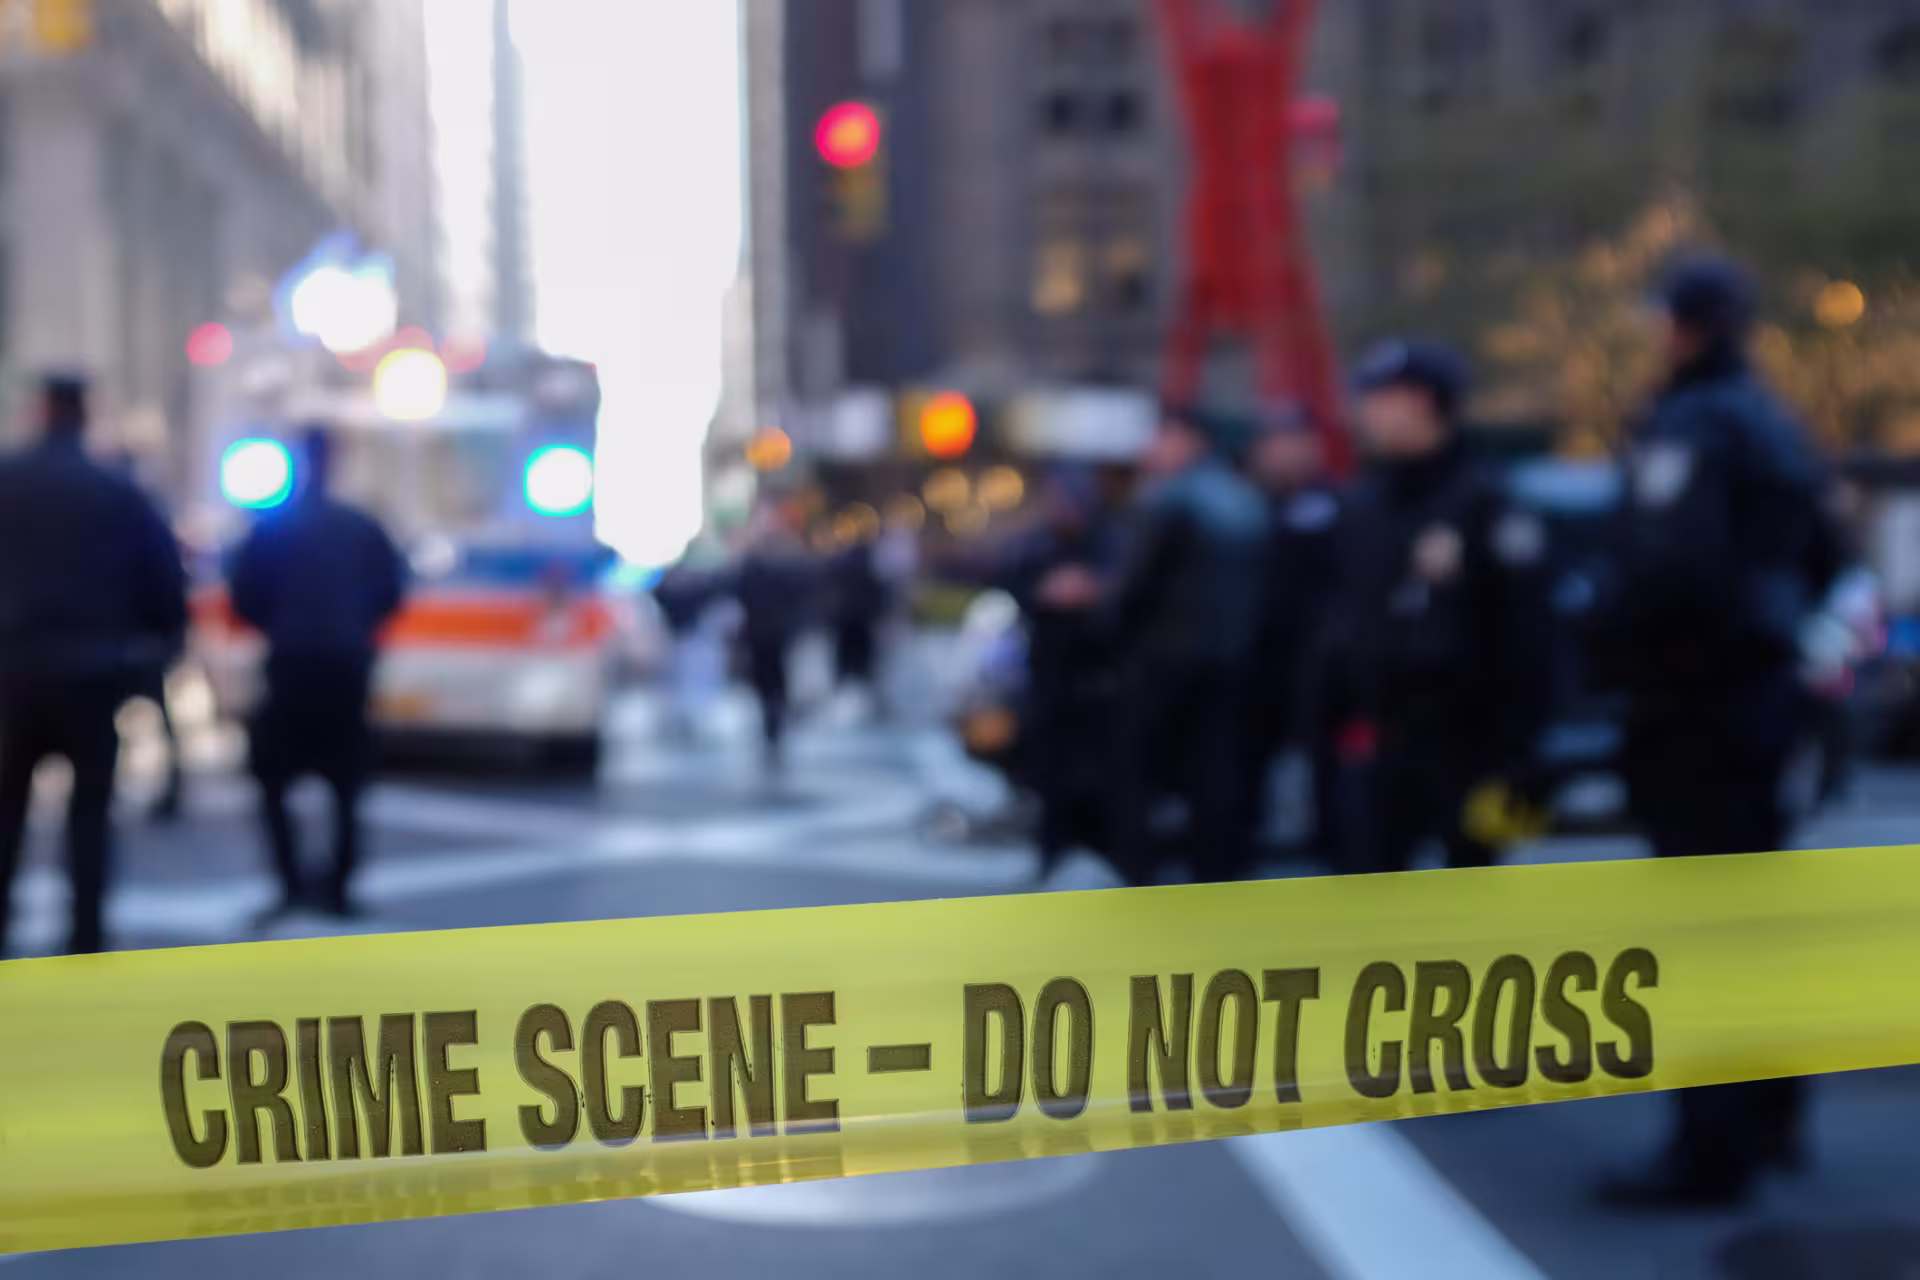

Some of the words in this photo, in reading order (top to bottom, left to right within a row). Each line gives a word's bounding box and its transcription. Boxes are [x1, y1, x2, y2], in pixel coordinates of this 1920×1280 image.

[160, 1009, 488, 1168] CRIME
[514, 990, 841, 1149] SCENE
[963, 976, 1094, 1124] DO
[1127, 966, 1321, 1114] NOT
[1344, 947, 1659, 1099] CROSS
